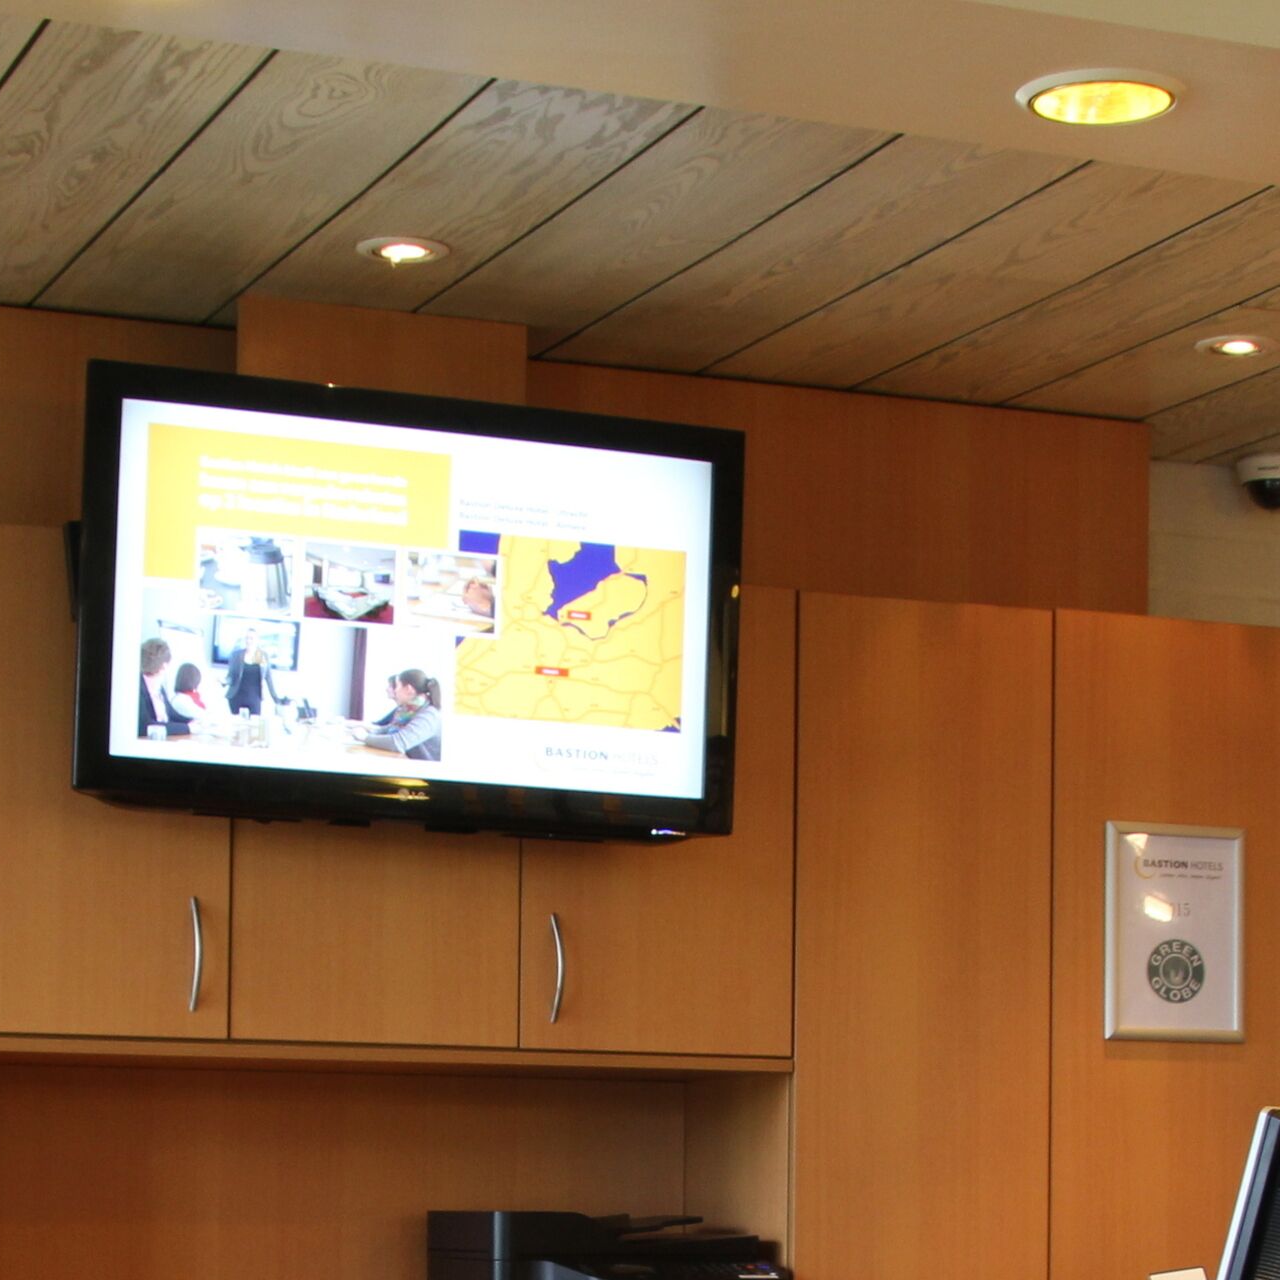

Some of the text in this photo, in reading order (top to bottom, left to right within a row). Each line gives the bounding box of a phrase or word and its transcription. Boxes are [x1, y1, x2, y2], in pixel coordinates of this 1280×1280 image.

[545, 746, 609, 760] BASTION
[1143, 858, 1225, 871] BASTION HOTELS
[1151, 941, 1202, 967] GREEN
[1151, 977, 1200, 1001] GLOBE
